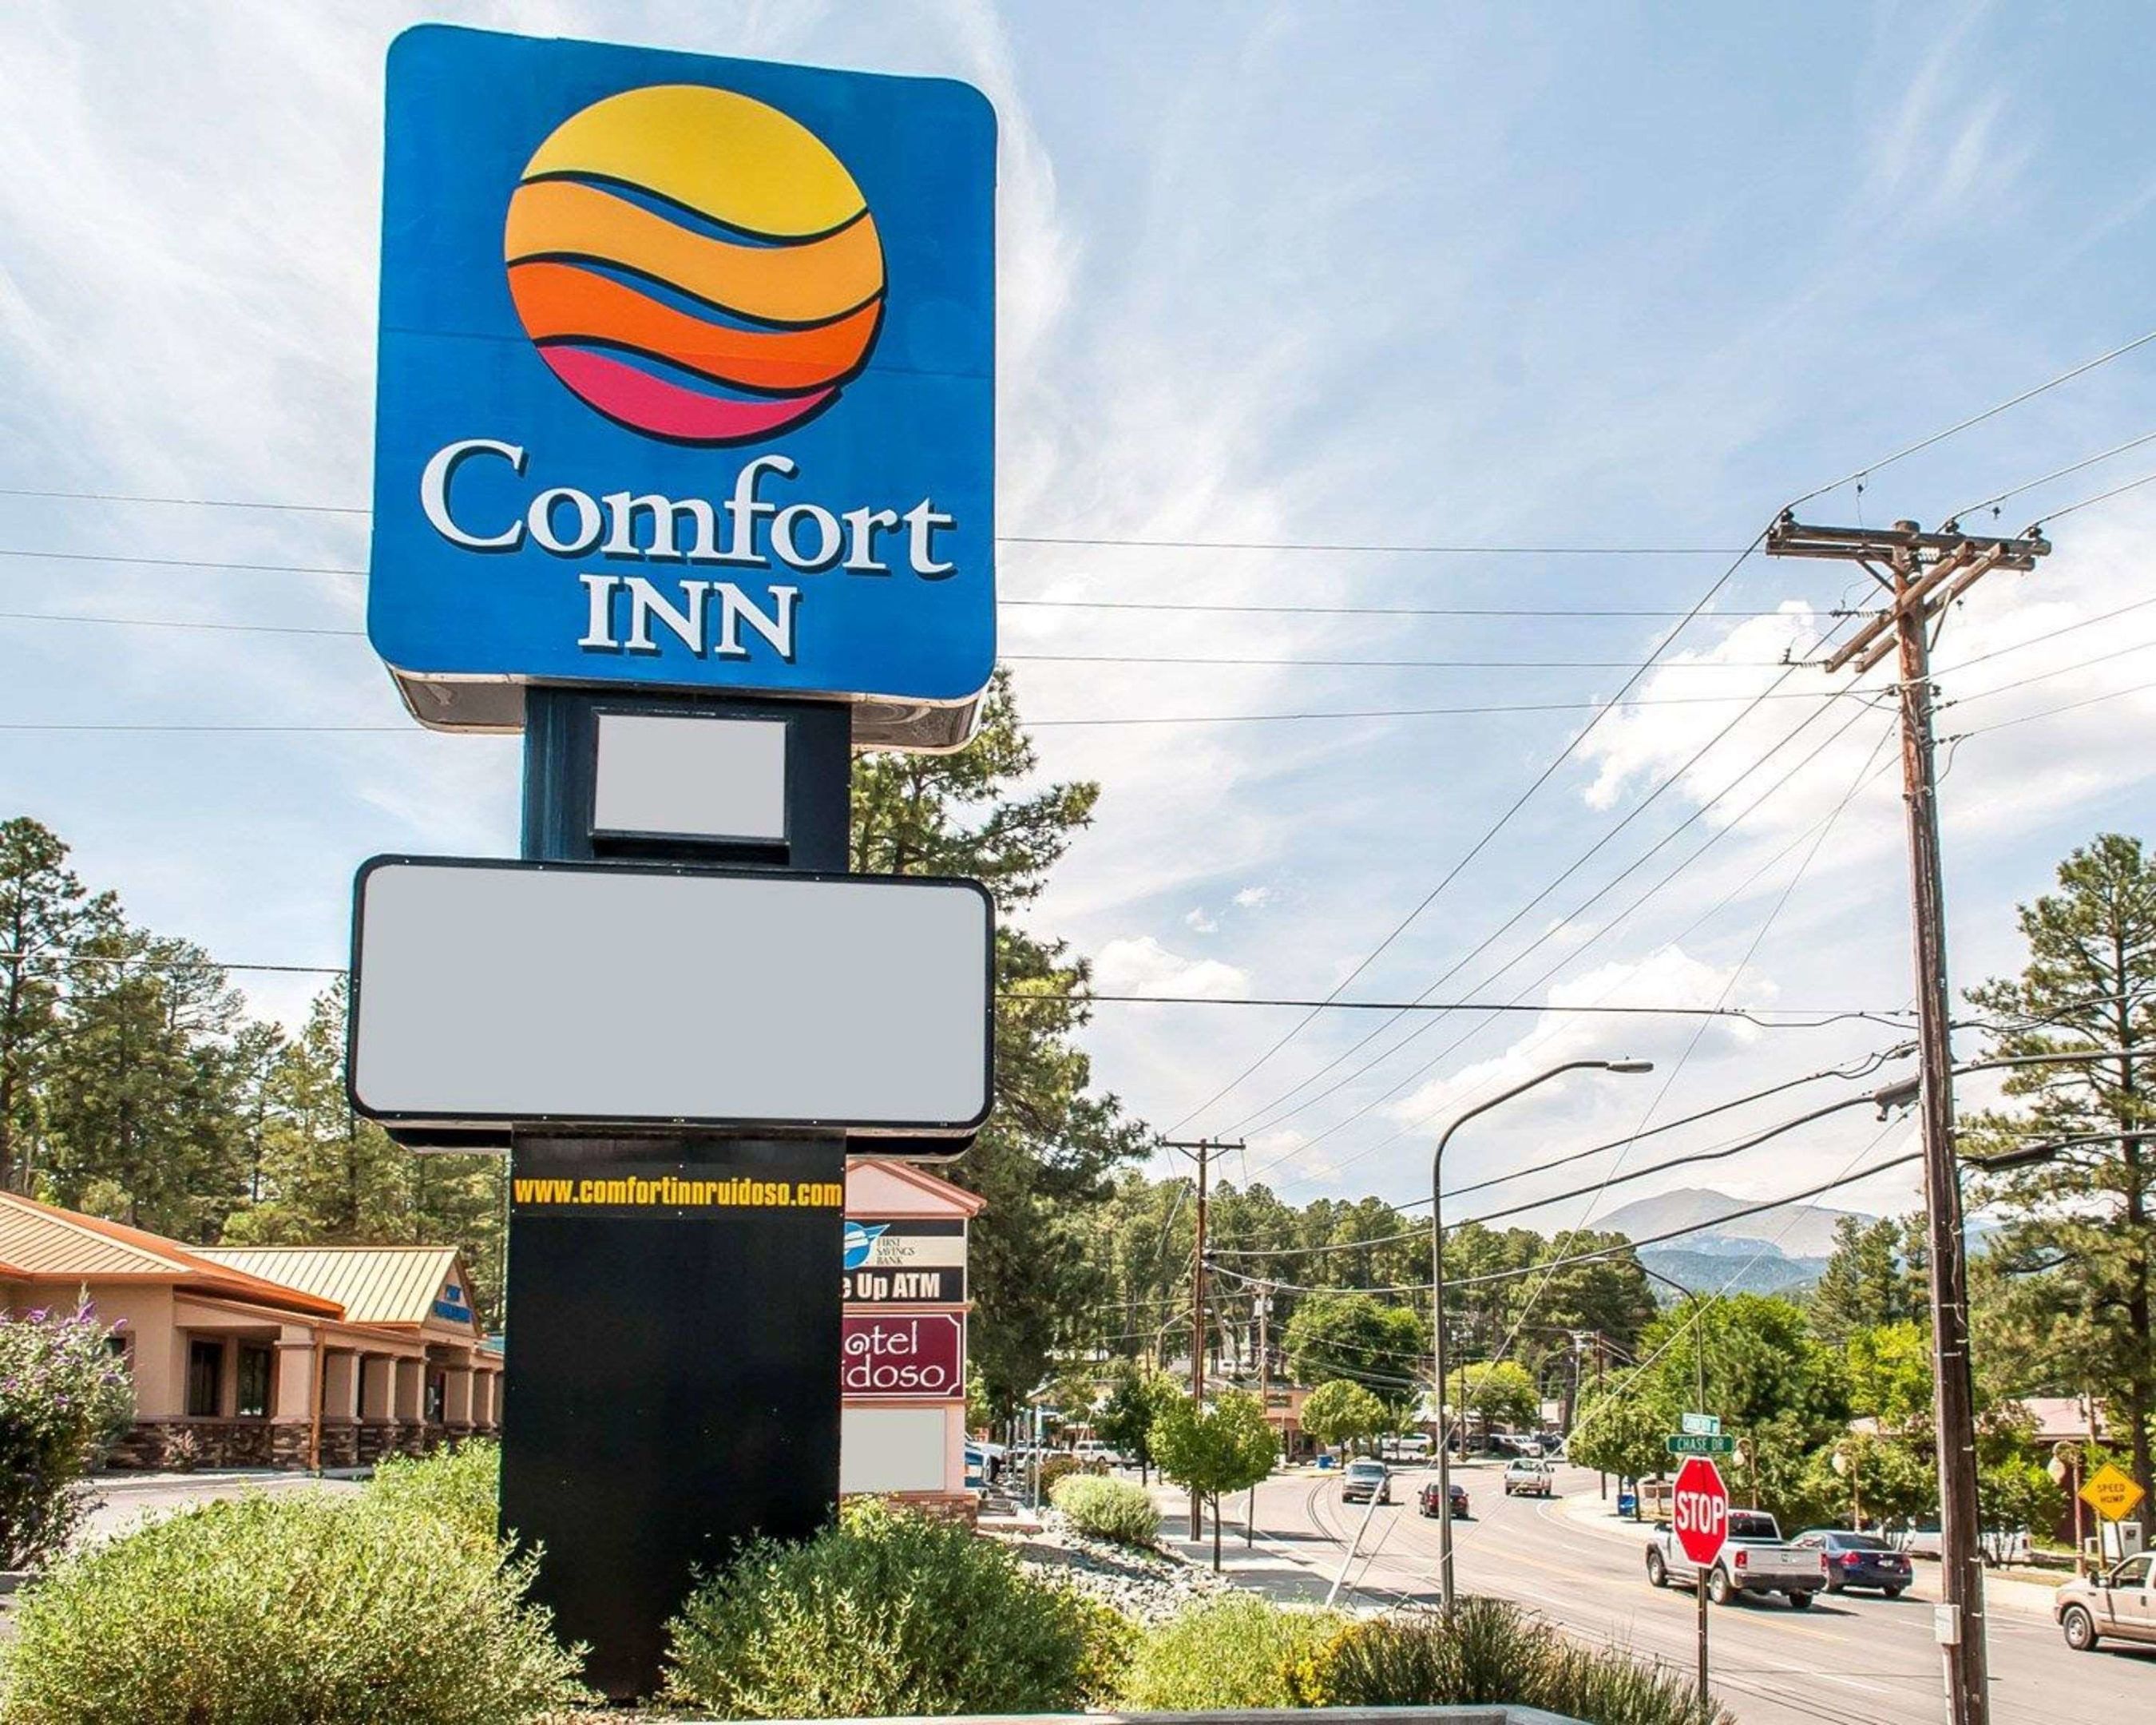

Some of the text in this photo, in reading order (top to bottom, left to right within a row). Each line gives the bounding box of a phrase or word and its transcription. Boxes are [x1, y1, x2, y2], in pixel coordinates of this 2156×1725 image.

[420, 438, 955, 577] Comfort
[578, 574, 799, 660] INN
[513, 1176, 843, 1207] www.comfortinnruidoso.com
[877, 1247, 916, 1256] SAVINGS
[877, 1256, 903, 1265] BANK
[857, 1272, 888, 1301] Up
[892, 1272, 941, 1298] ATM
[1678, 1438, 1707, 1451] CHASE
[2096, 1483, 2126, 1493] SPEED
[1677, 1490, 1725, 1536] STOP
